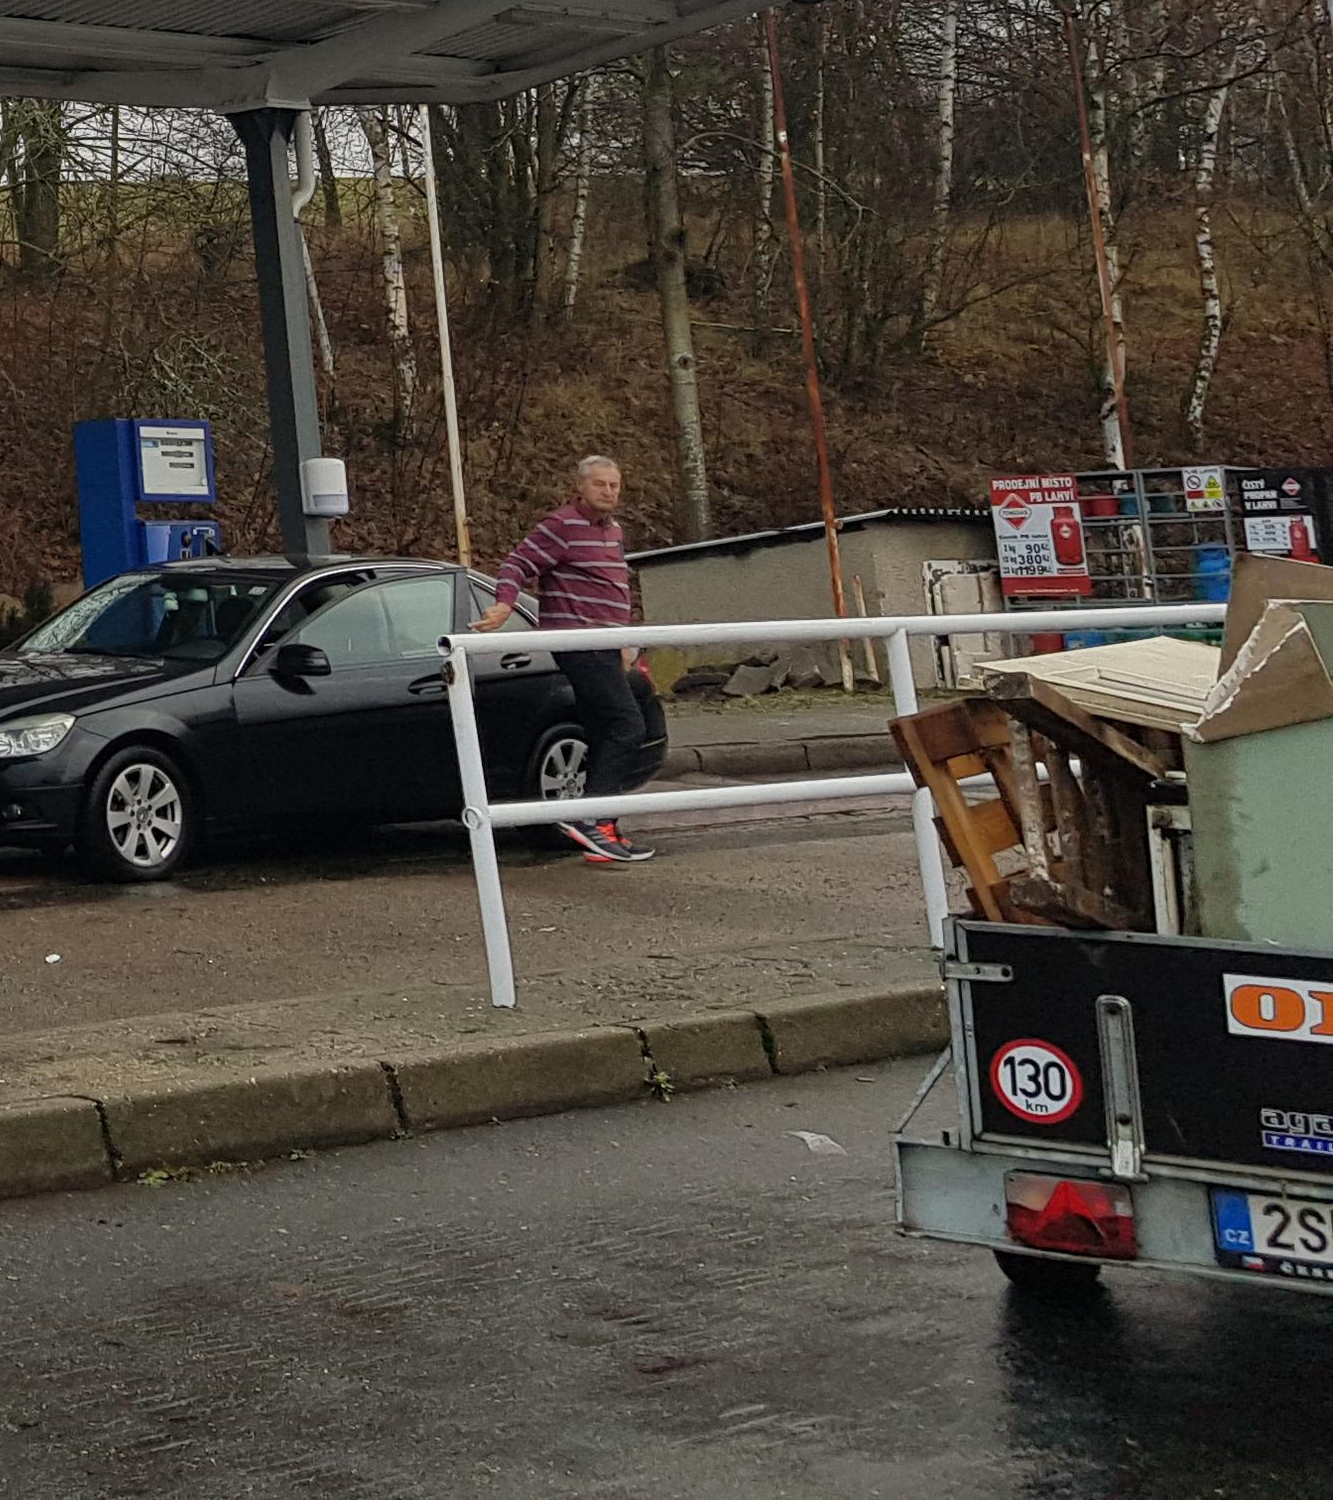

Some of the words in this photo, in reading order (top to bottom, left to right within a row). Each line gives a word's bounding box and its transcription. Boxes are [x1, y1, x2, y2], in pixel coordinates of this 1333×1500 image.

[992, 476, 1040, 490] PRODEJNÍ
[1025, 543, 1041, 554] 90
[1018, 554, 1042, 565] 380
[1003, 1056, 1067, 1102] 130
[1025, 1099, 1048, 1113] km
[1263, 1203, 1333, 1253] 2S
[1224, 1228, 1251, 1245] CZ
